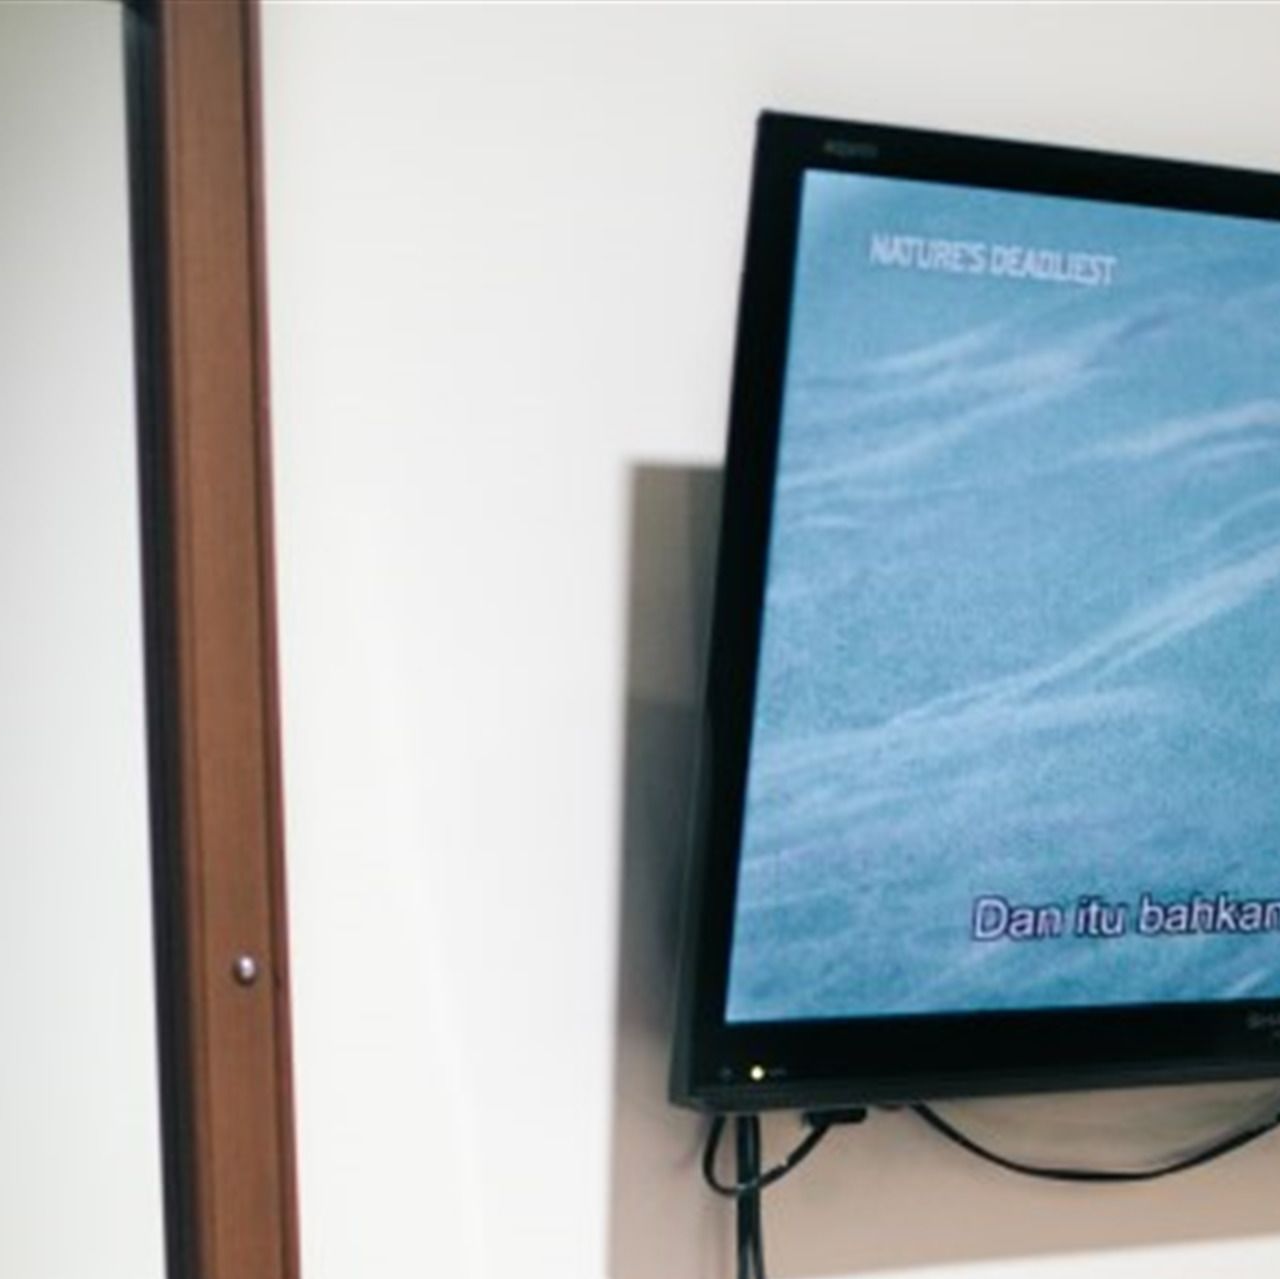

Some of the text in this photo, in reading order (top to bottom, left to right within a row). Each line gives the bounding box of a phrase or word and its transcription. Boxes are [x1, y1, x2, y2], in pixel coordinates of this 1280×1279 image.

[870, 233, 1117, 286] NATURE'S DEADLIEST
[973, 896, 1062, 940] Dan
[1077, 894, 1124, 936] itu
